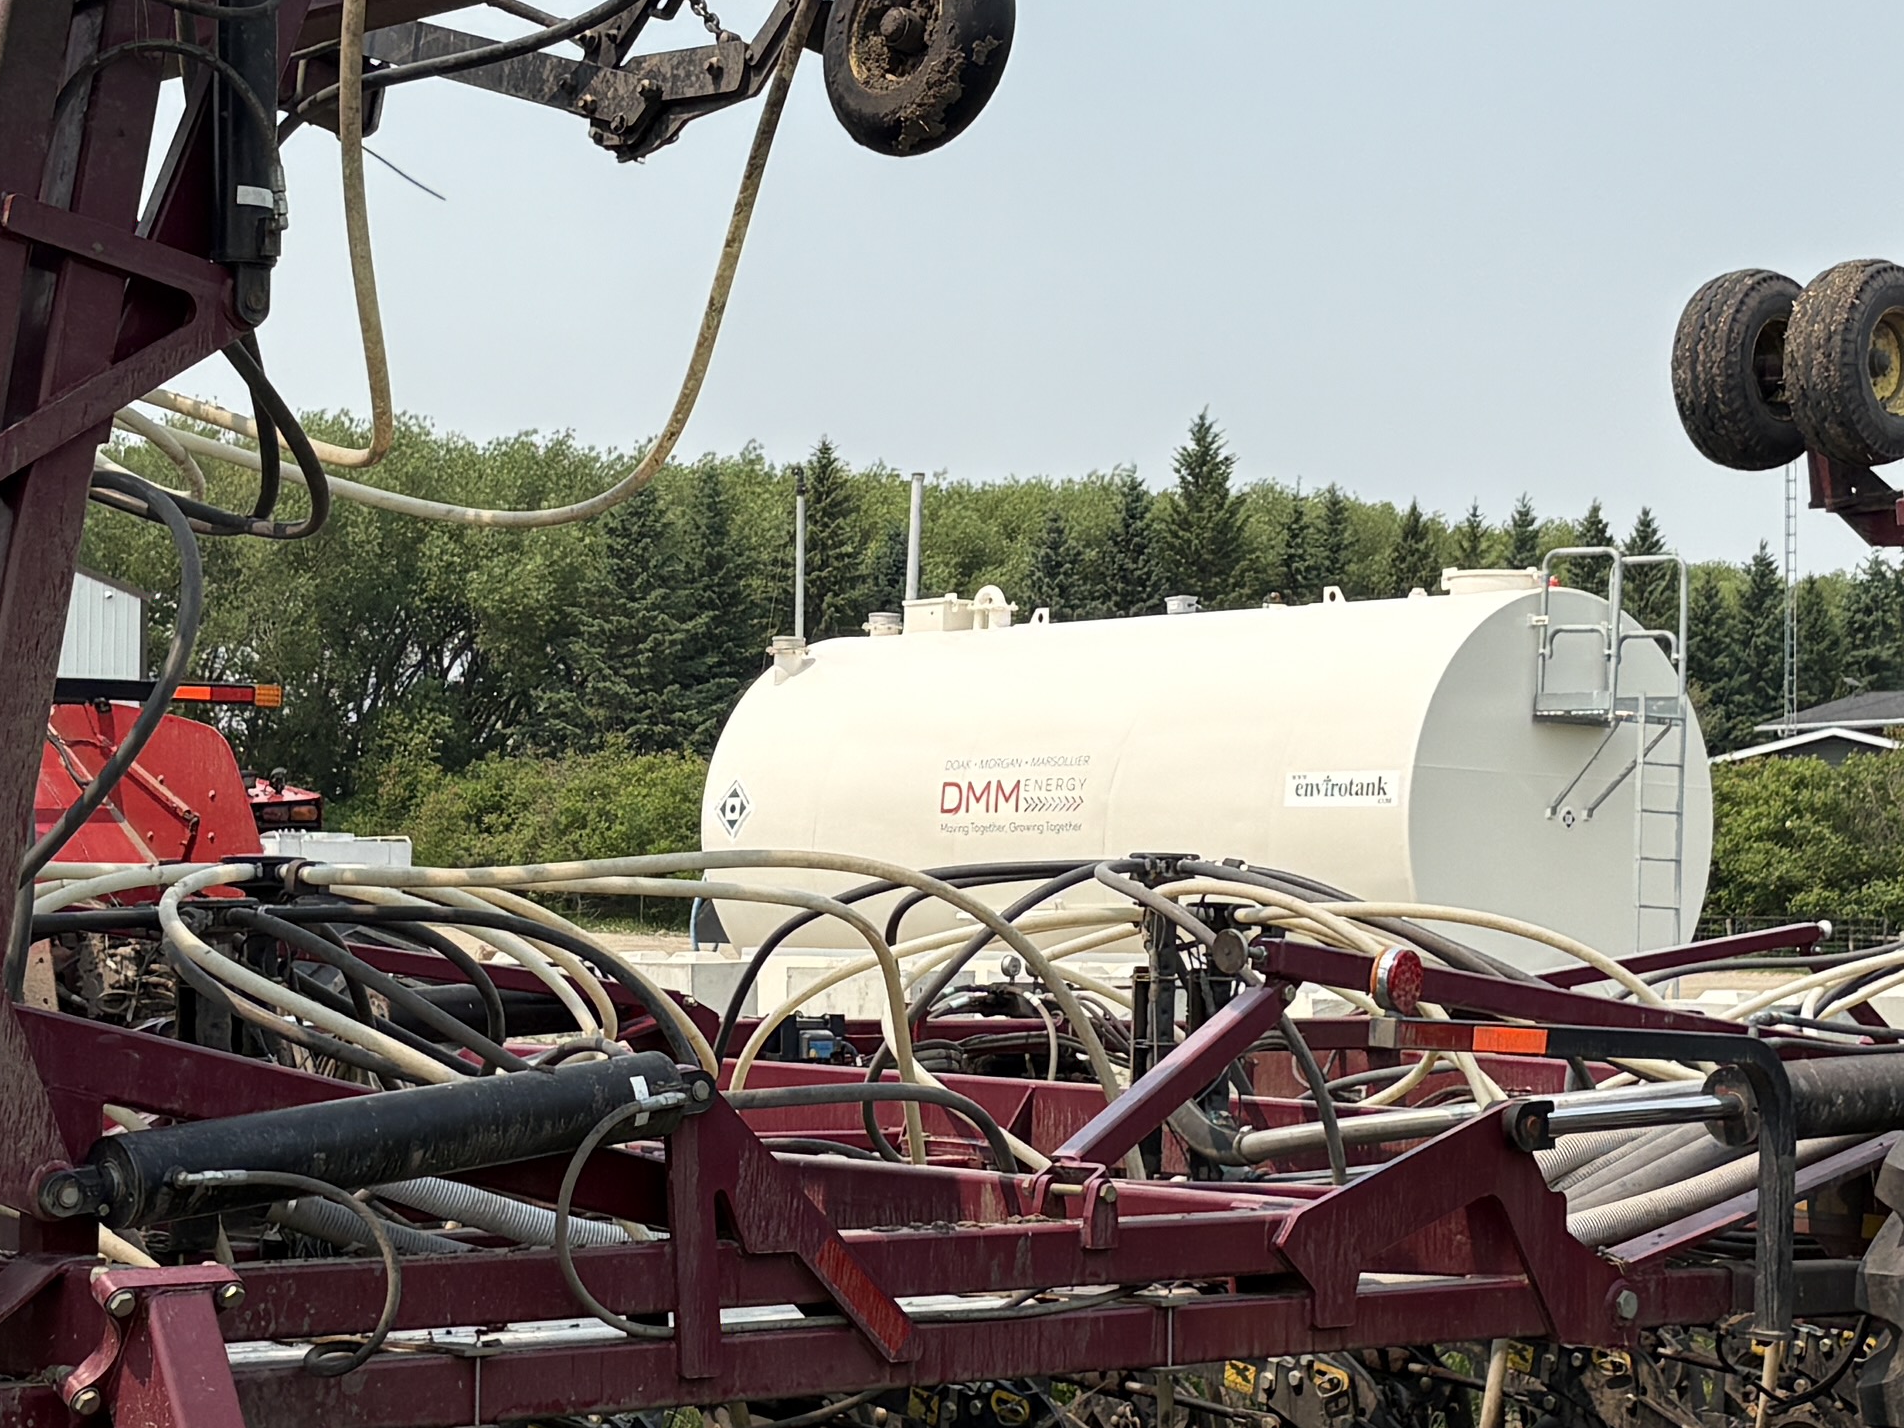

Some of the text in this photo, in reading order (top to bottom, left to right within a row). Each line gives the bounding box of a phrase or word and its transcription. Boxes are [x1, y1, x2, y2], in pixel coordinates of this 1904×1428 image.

[978, 757, 1023, 770] MORGAN
[1024, 777, 1087, 792] ENERGY
[1295, 775, 1388, 797] envirotank
[940, 779, 1021, 815] DMM
[940, 823, 969, 836] Moving
[1009, 822, 1044, 835] Growing
[1046, 821, 1082, 835] Together
